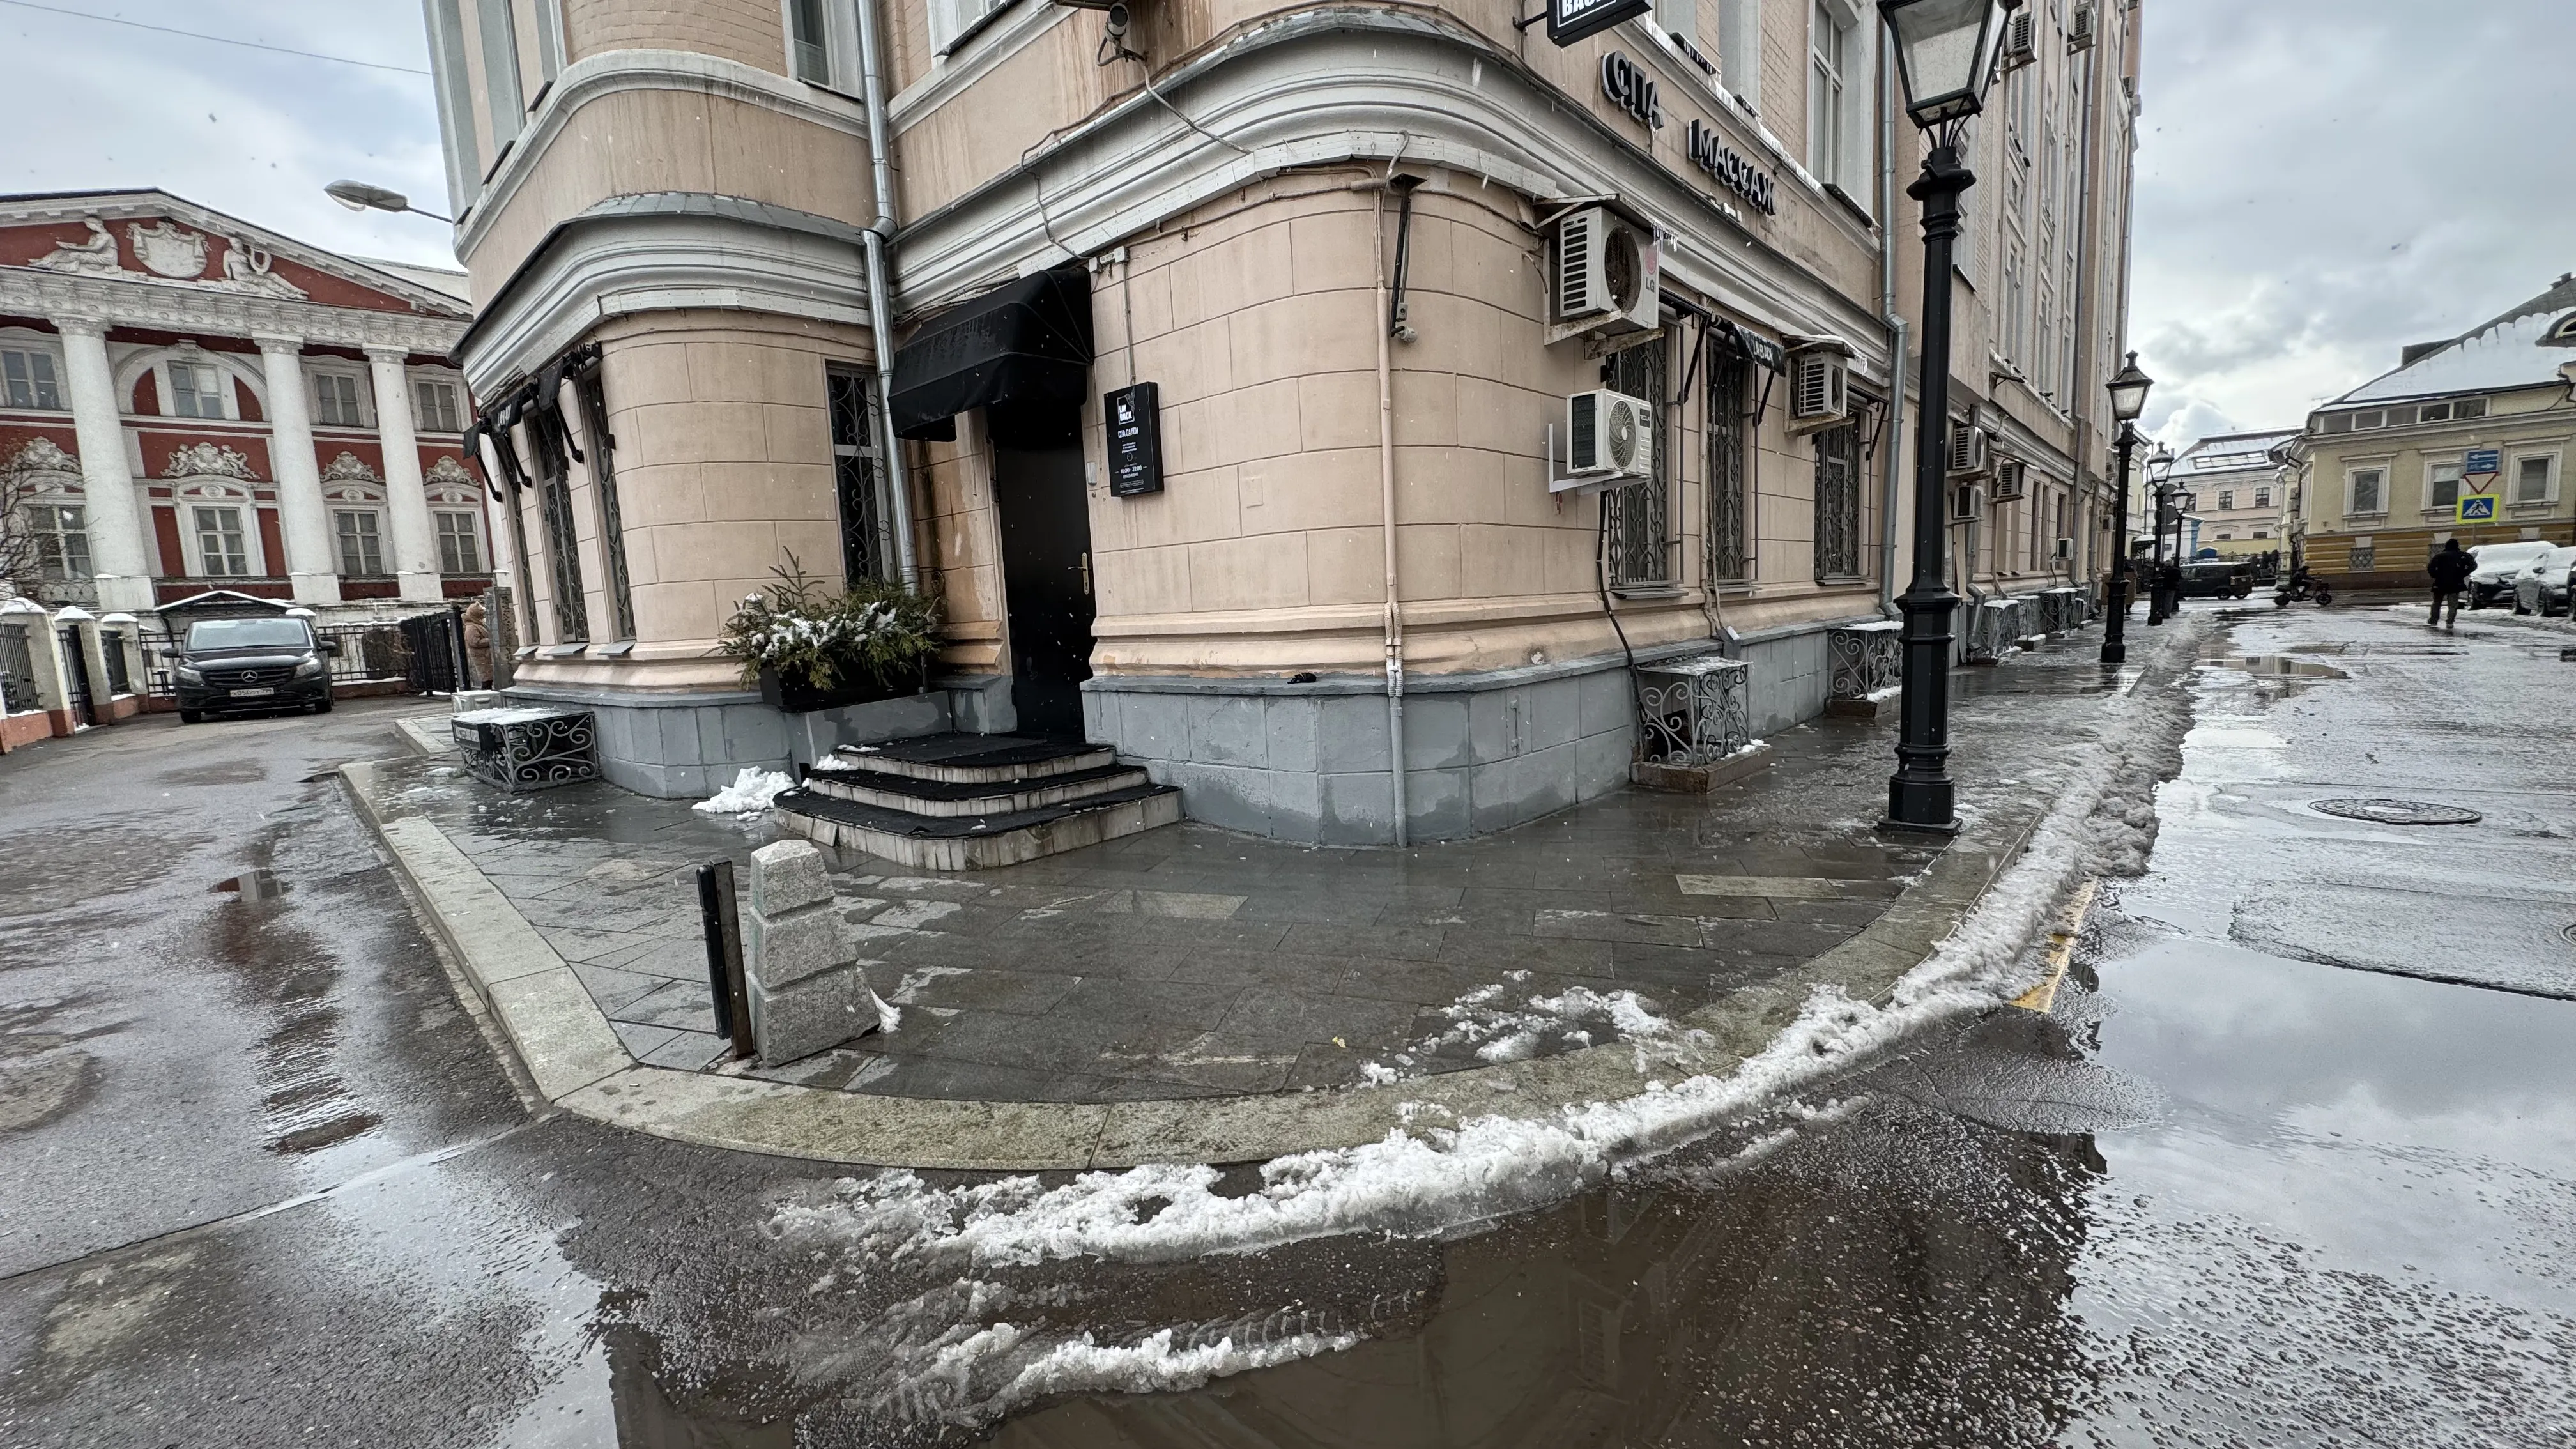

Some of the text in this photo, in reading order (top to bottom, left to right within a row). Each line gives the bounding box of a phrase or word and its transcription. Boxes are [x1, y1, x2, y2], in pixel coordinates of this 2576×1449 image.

[1602, 50, 1775, 217] СПА МАССАЖ
[1645, 276, 1655, 293] LG
